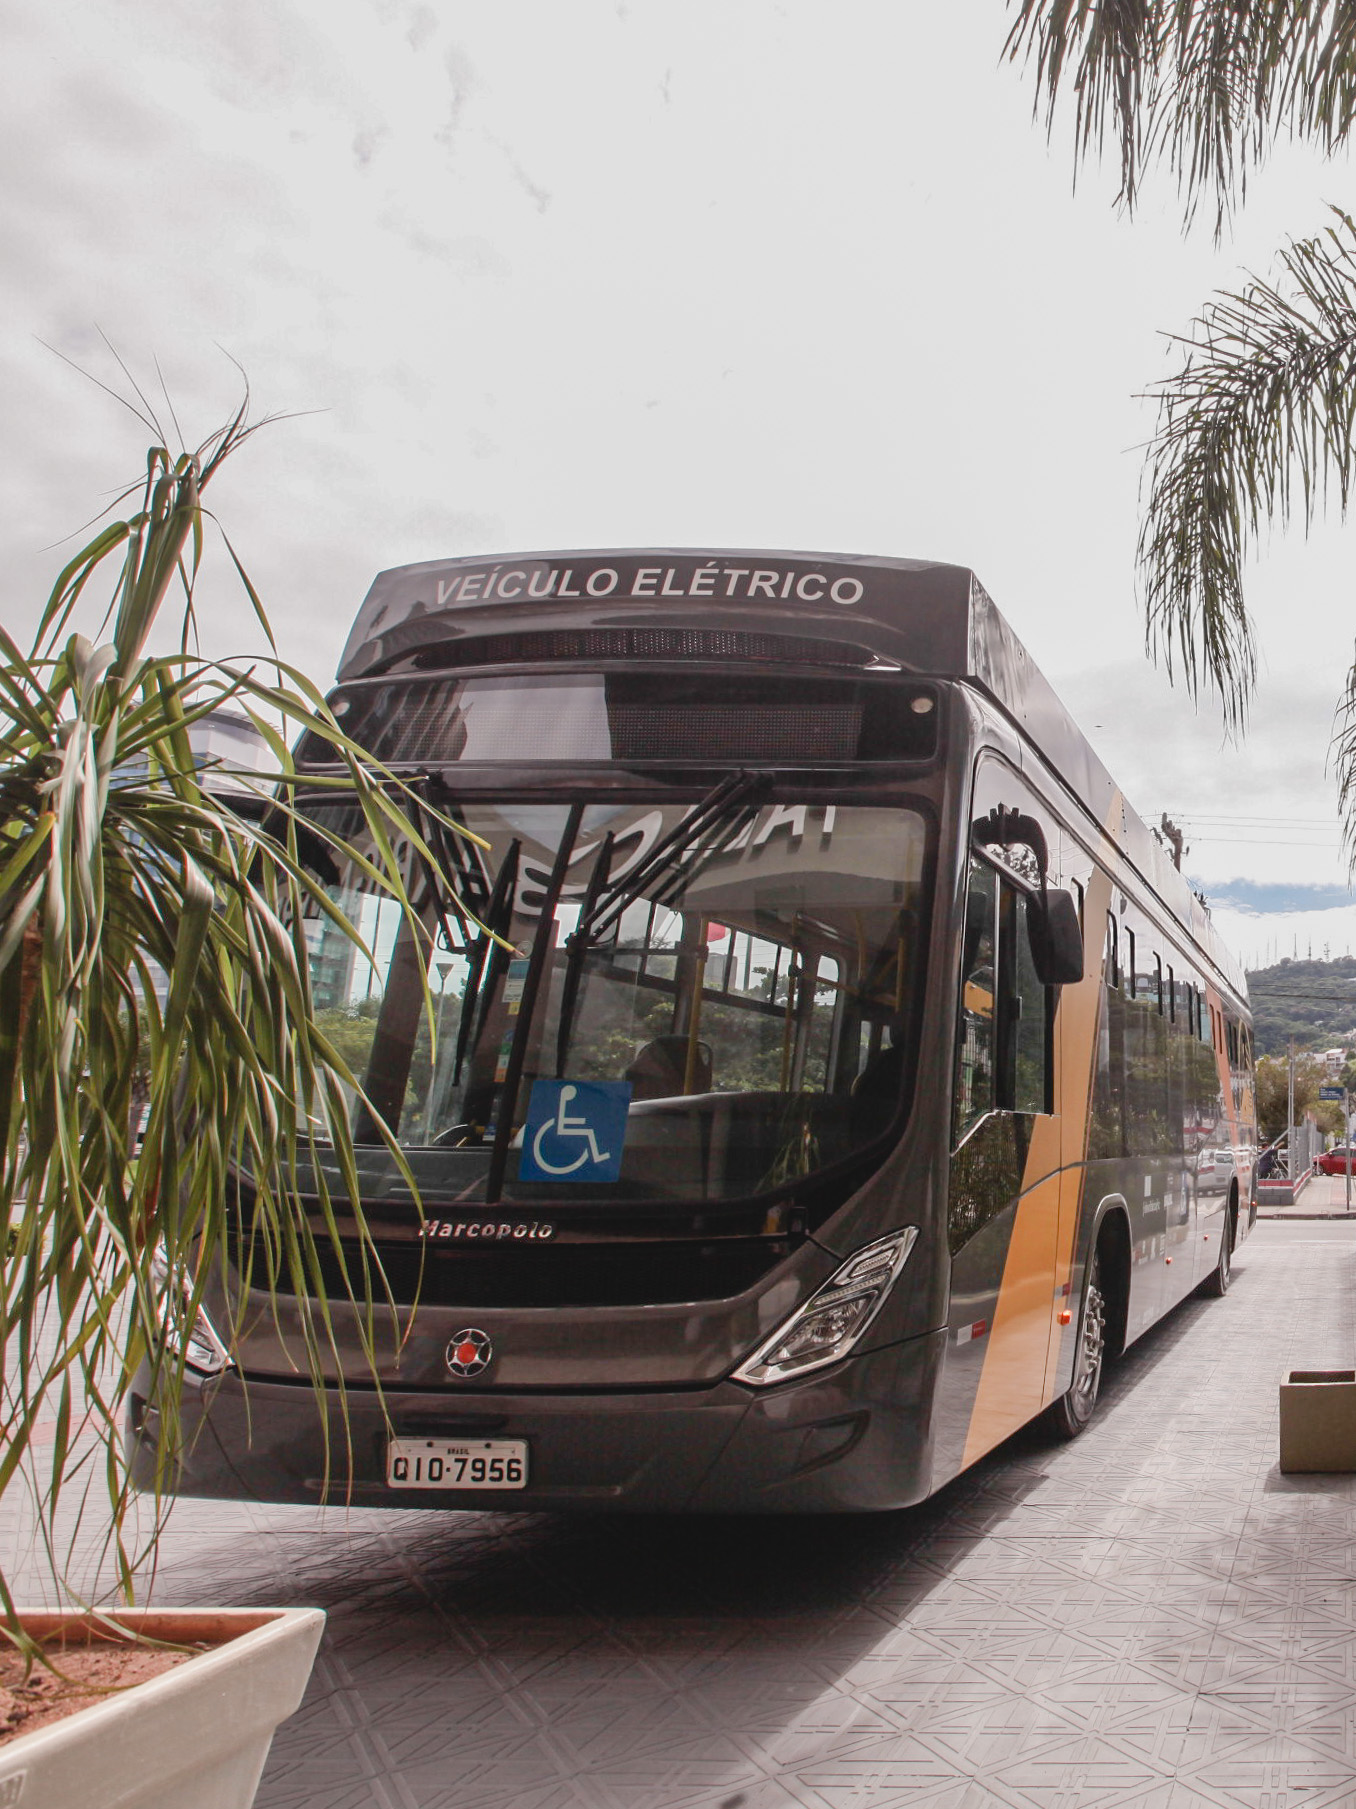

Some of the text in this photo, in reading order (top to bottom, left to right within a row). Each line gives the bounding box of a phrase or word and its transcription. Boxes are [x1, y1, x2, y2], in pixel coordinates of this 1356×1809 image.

[436, 562, 864, 605] VEÍCULO ELÉTRICO
[418, 1219, 553, 1240] Marcopolo
